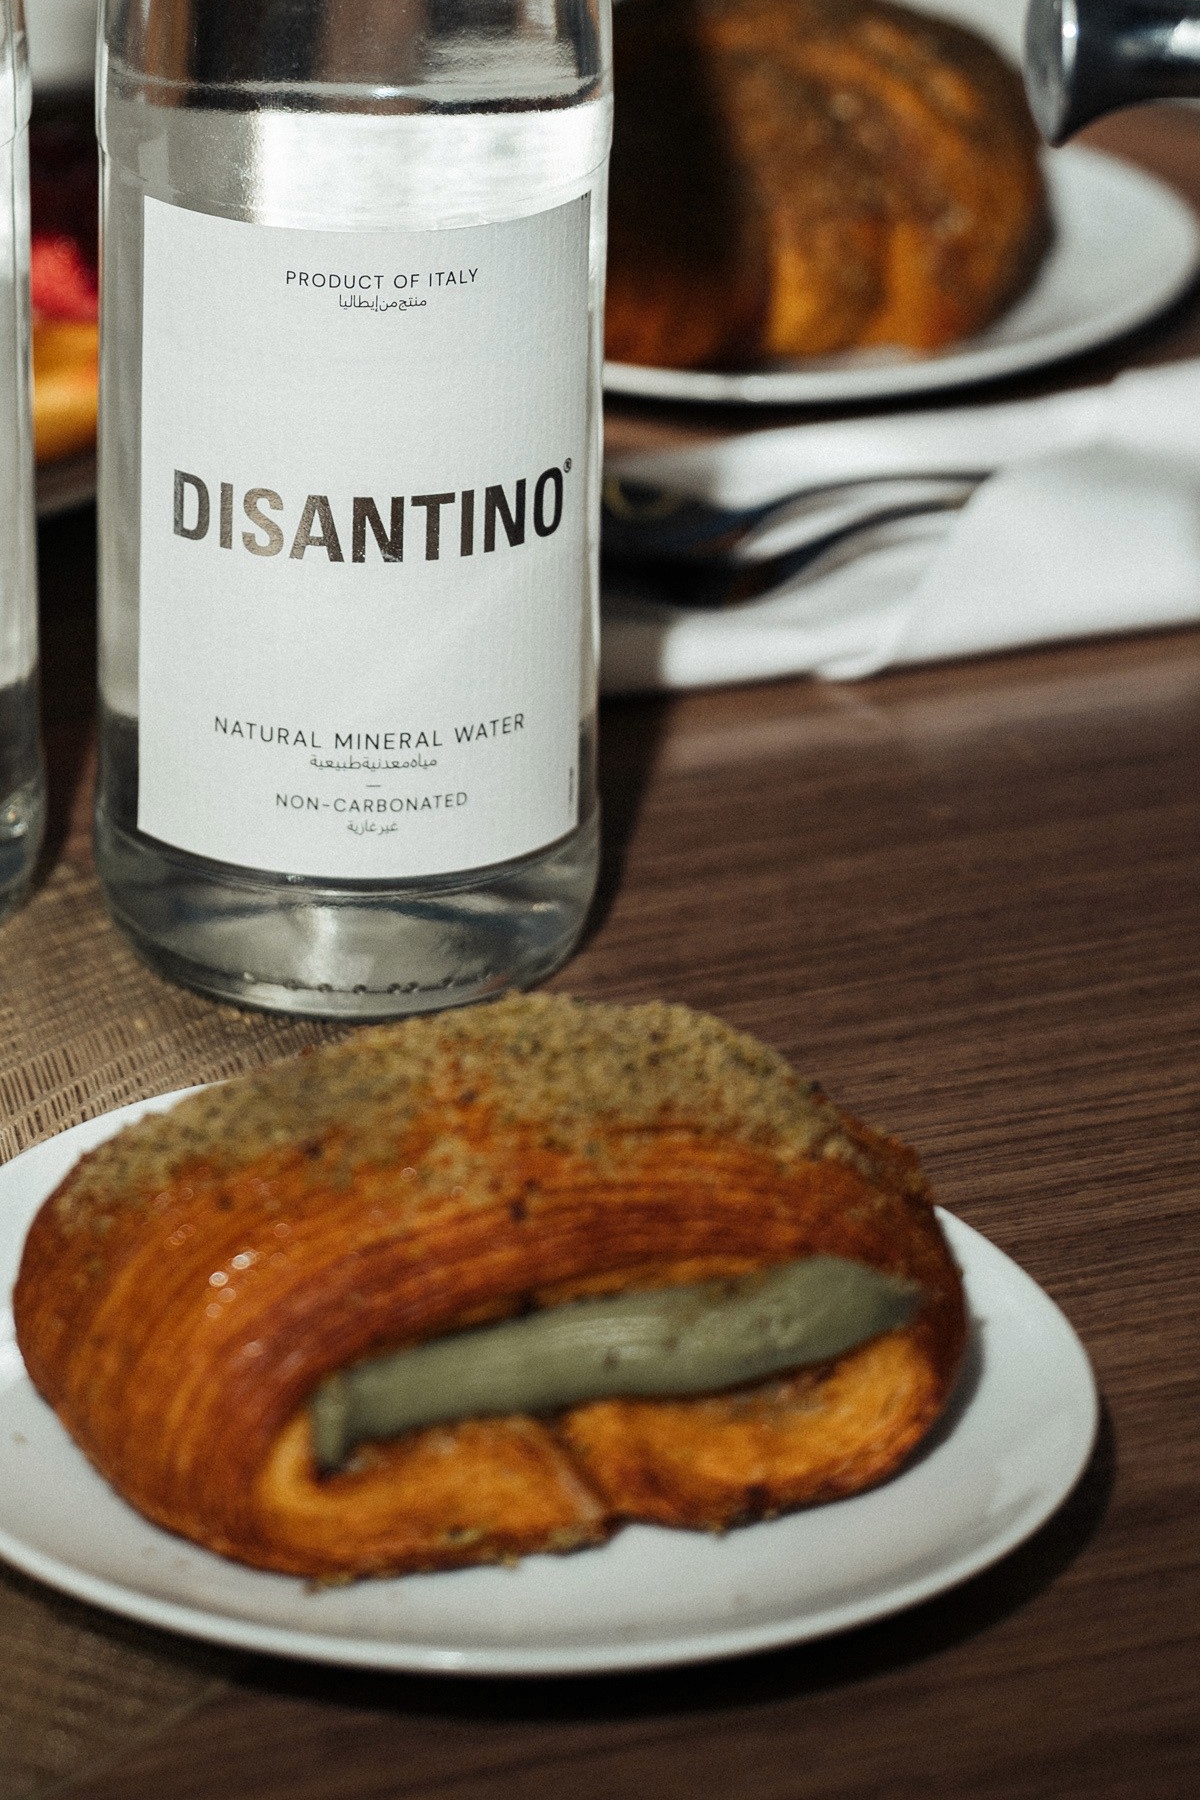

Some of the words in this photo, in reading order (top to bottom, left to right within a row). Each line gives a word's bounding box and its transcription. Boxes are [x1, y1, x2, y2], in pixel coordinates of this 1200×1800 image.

[286, 270, 384, 290] PRODUCT
[393, 273, 420, 289] OF
[429, 267, 479, 287] ITALY
[214, 715, 322, 749] NATURAL
[334, 730, 443, 751] MINERAL
[454, 712, 525, 744] WATER
[276, 791, 468, 813] NON-CARBONATED
